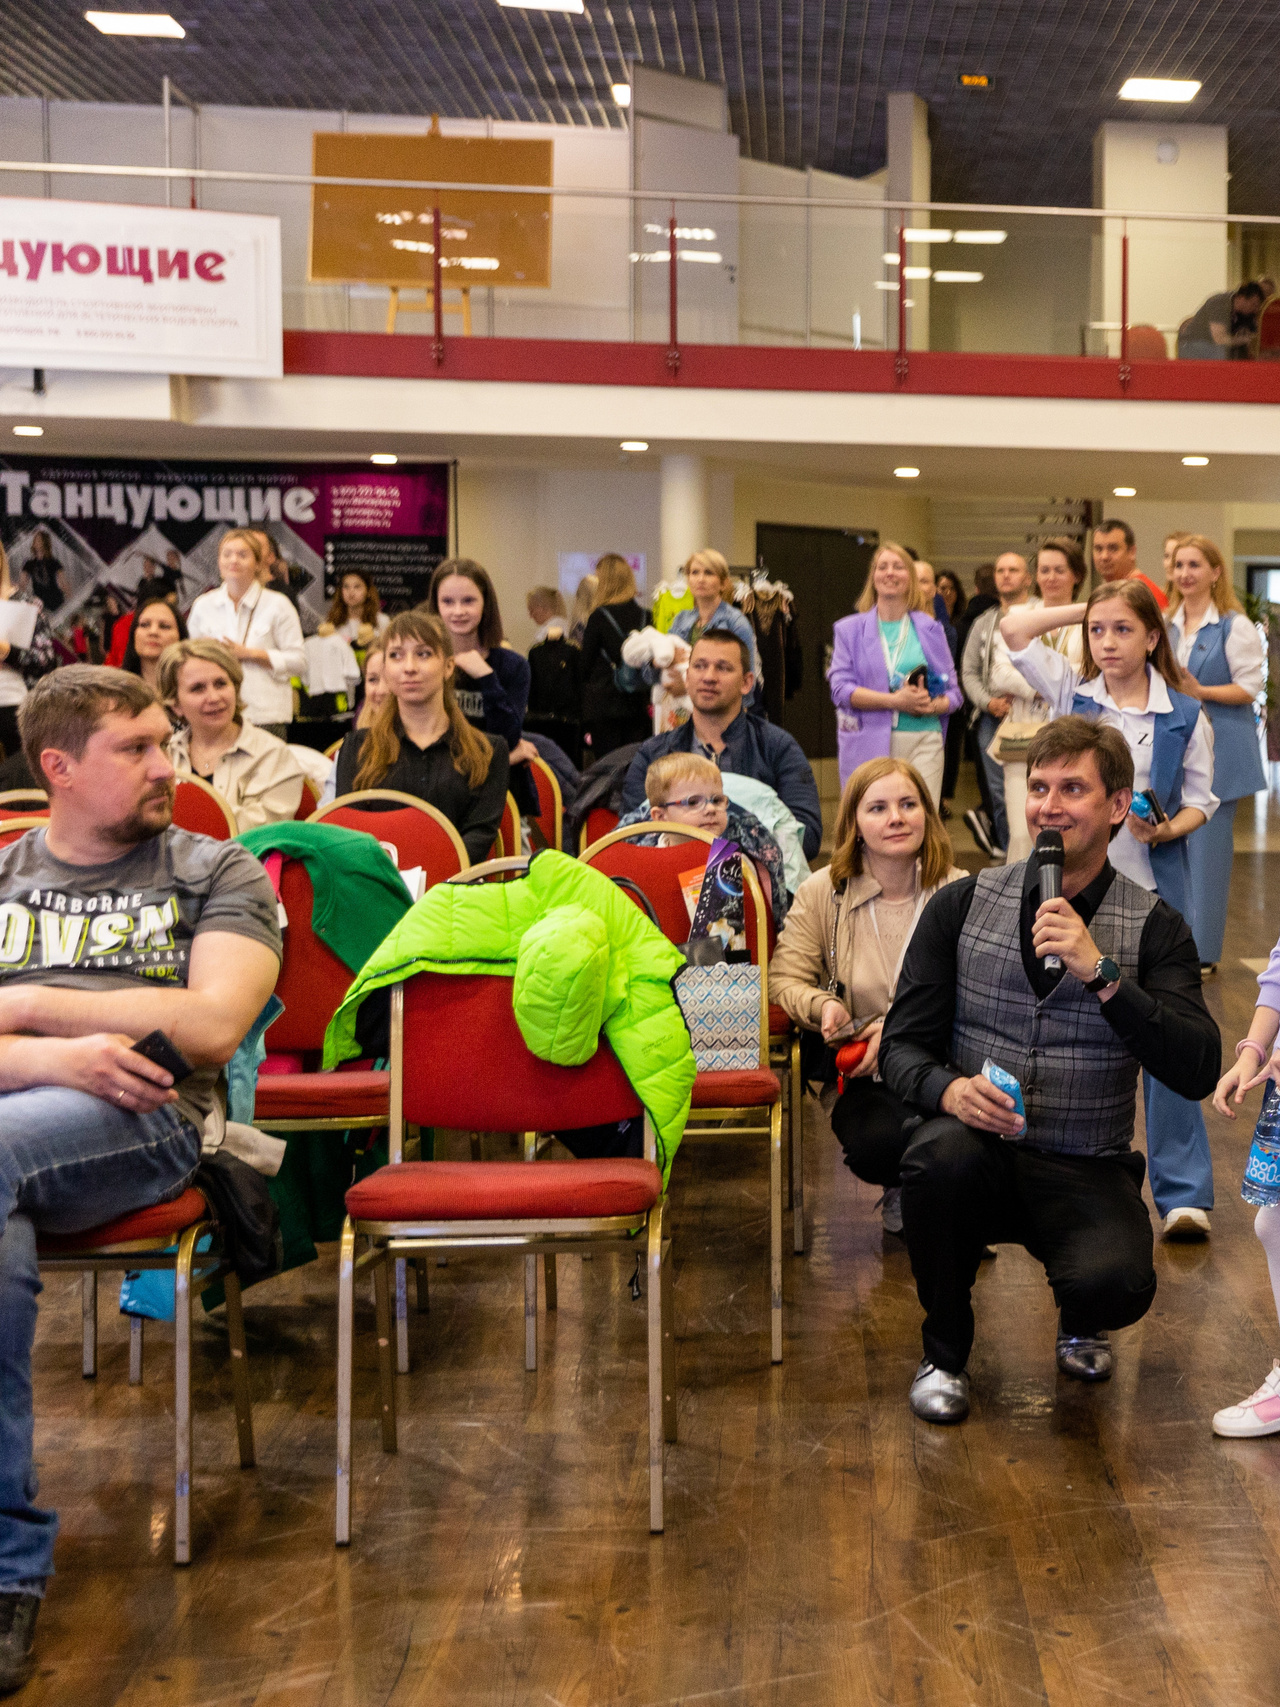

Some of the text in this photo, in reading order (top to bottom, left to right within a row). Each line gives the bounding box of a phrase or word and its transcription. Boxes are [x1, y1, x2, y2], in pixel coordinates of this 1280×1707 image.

[0, 470, 317, 529] Танцующие
[28, 888, 143, 914] AIRBORNE
[1252, 1155, 1278, 1175] bon
